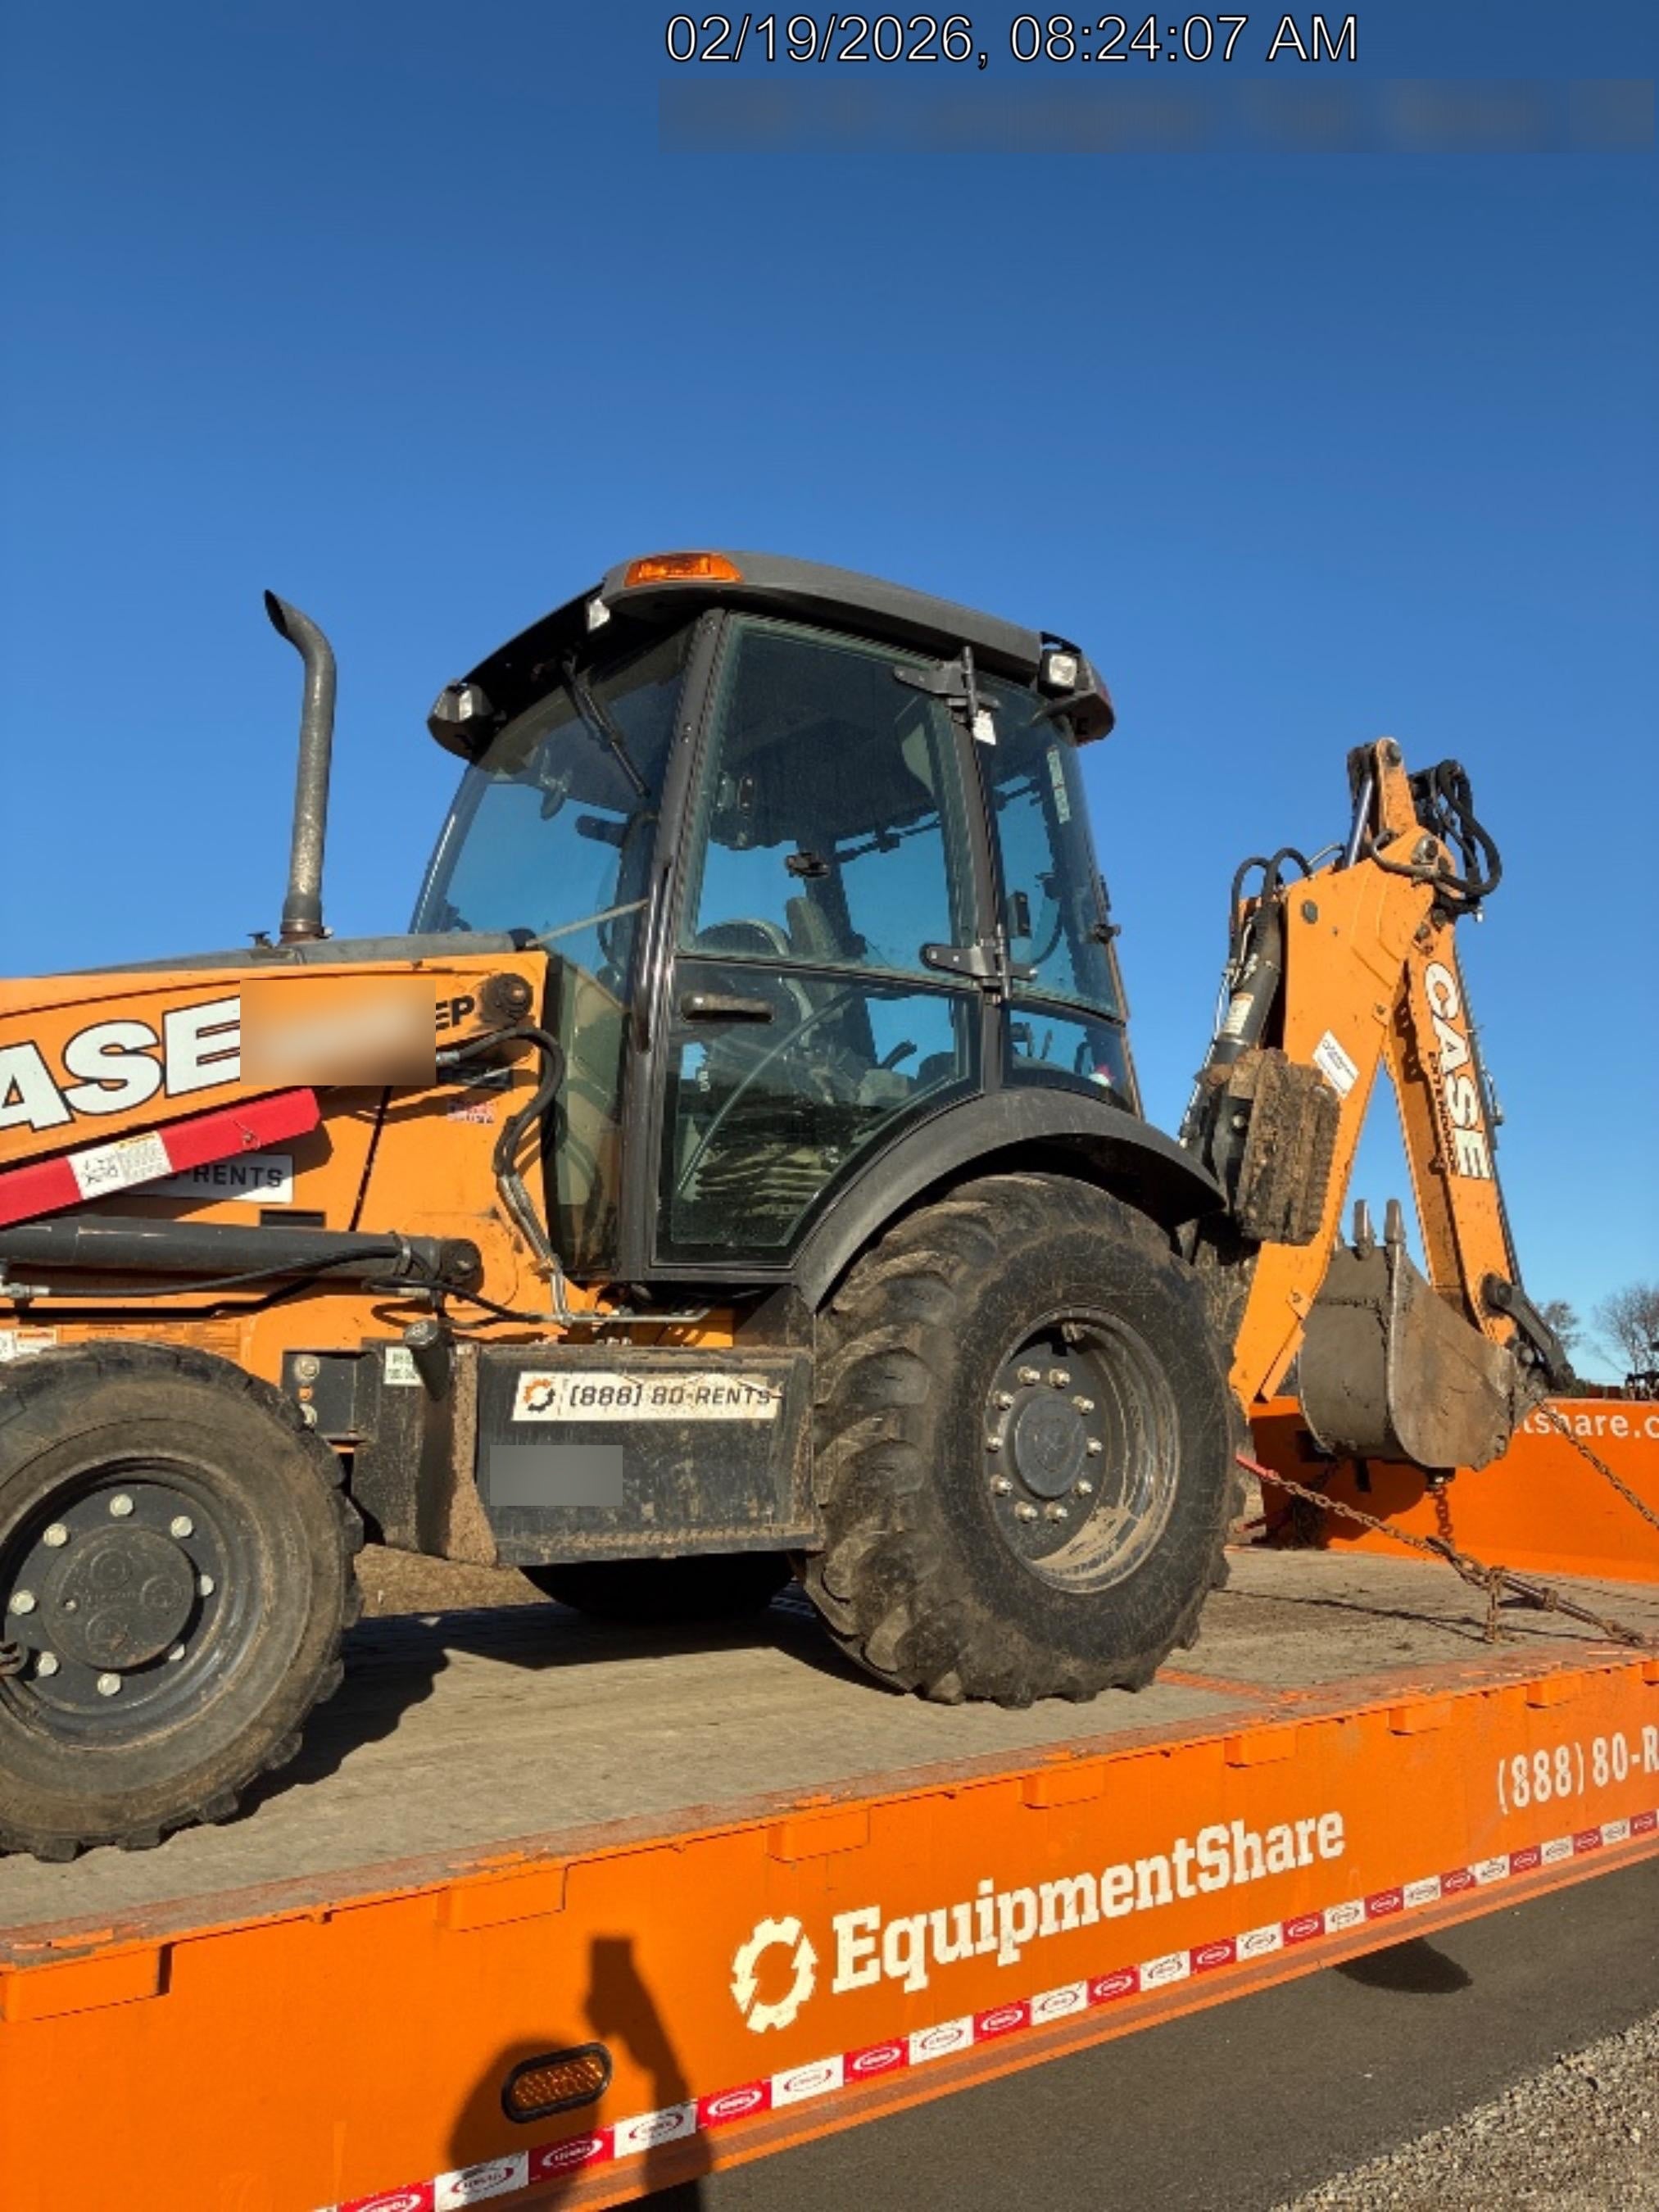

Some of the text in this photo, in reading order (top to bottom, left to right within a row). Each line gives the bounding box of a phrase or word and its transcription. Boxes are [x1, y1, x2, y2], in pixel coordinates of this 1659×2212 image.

[1424, 961, 1490, 1180] CASE
[650, 1385, 771, 1406] 80-RENTS
[1497, 1725, 1659, 1814] (888) 80-R
[832, 1811, 1346, 1993] EquipmentShare
